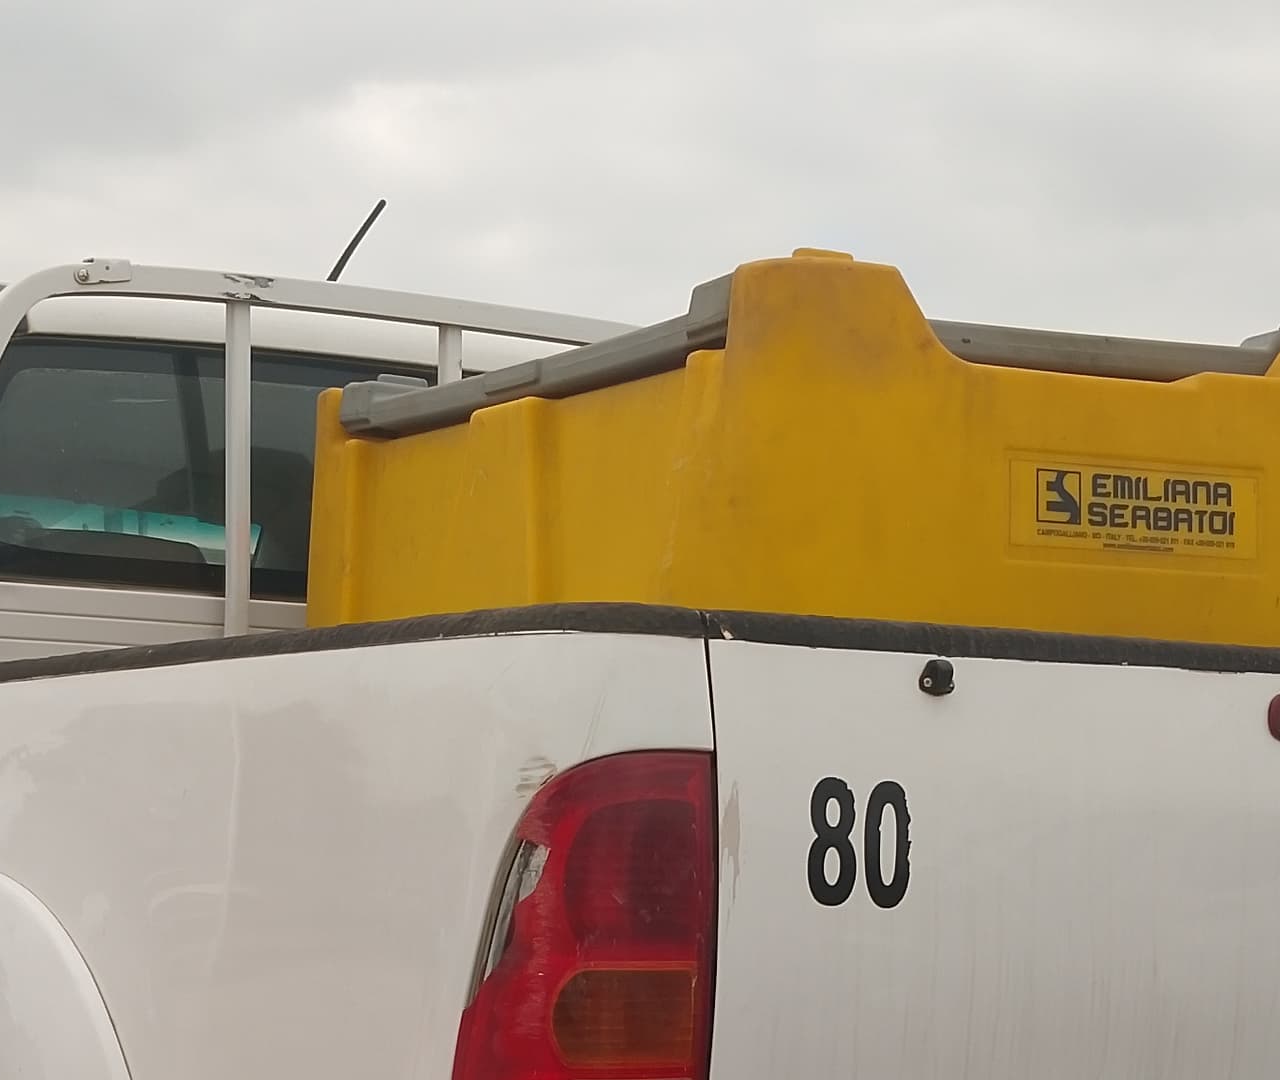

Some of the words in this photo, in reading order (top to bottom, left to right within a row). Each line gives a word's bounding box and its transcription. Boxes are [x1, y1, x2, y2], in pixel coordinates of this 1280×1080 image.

[1091, 473, 1233, 507] EMILIANA
[1087, 502, 1236, 536] SERBATOI
[807, 776, 912, 909] 80
